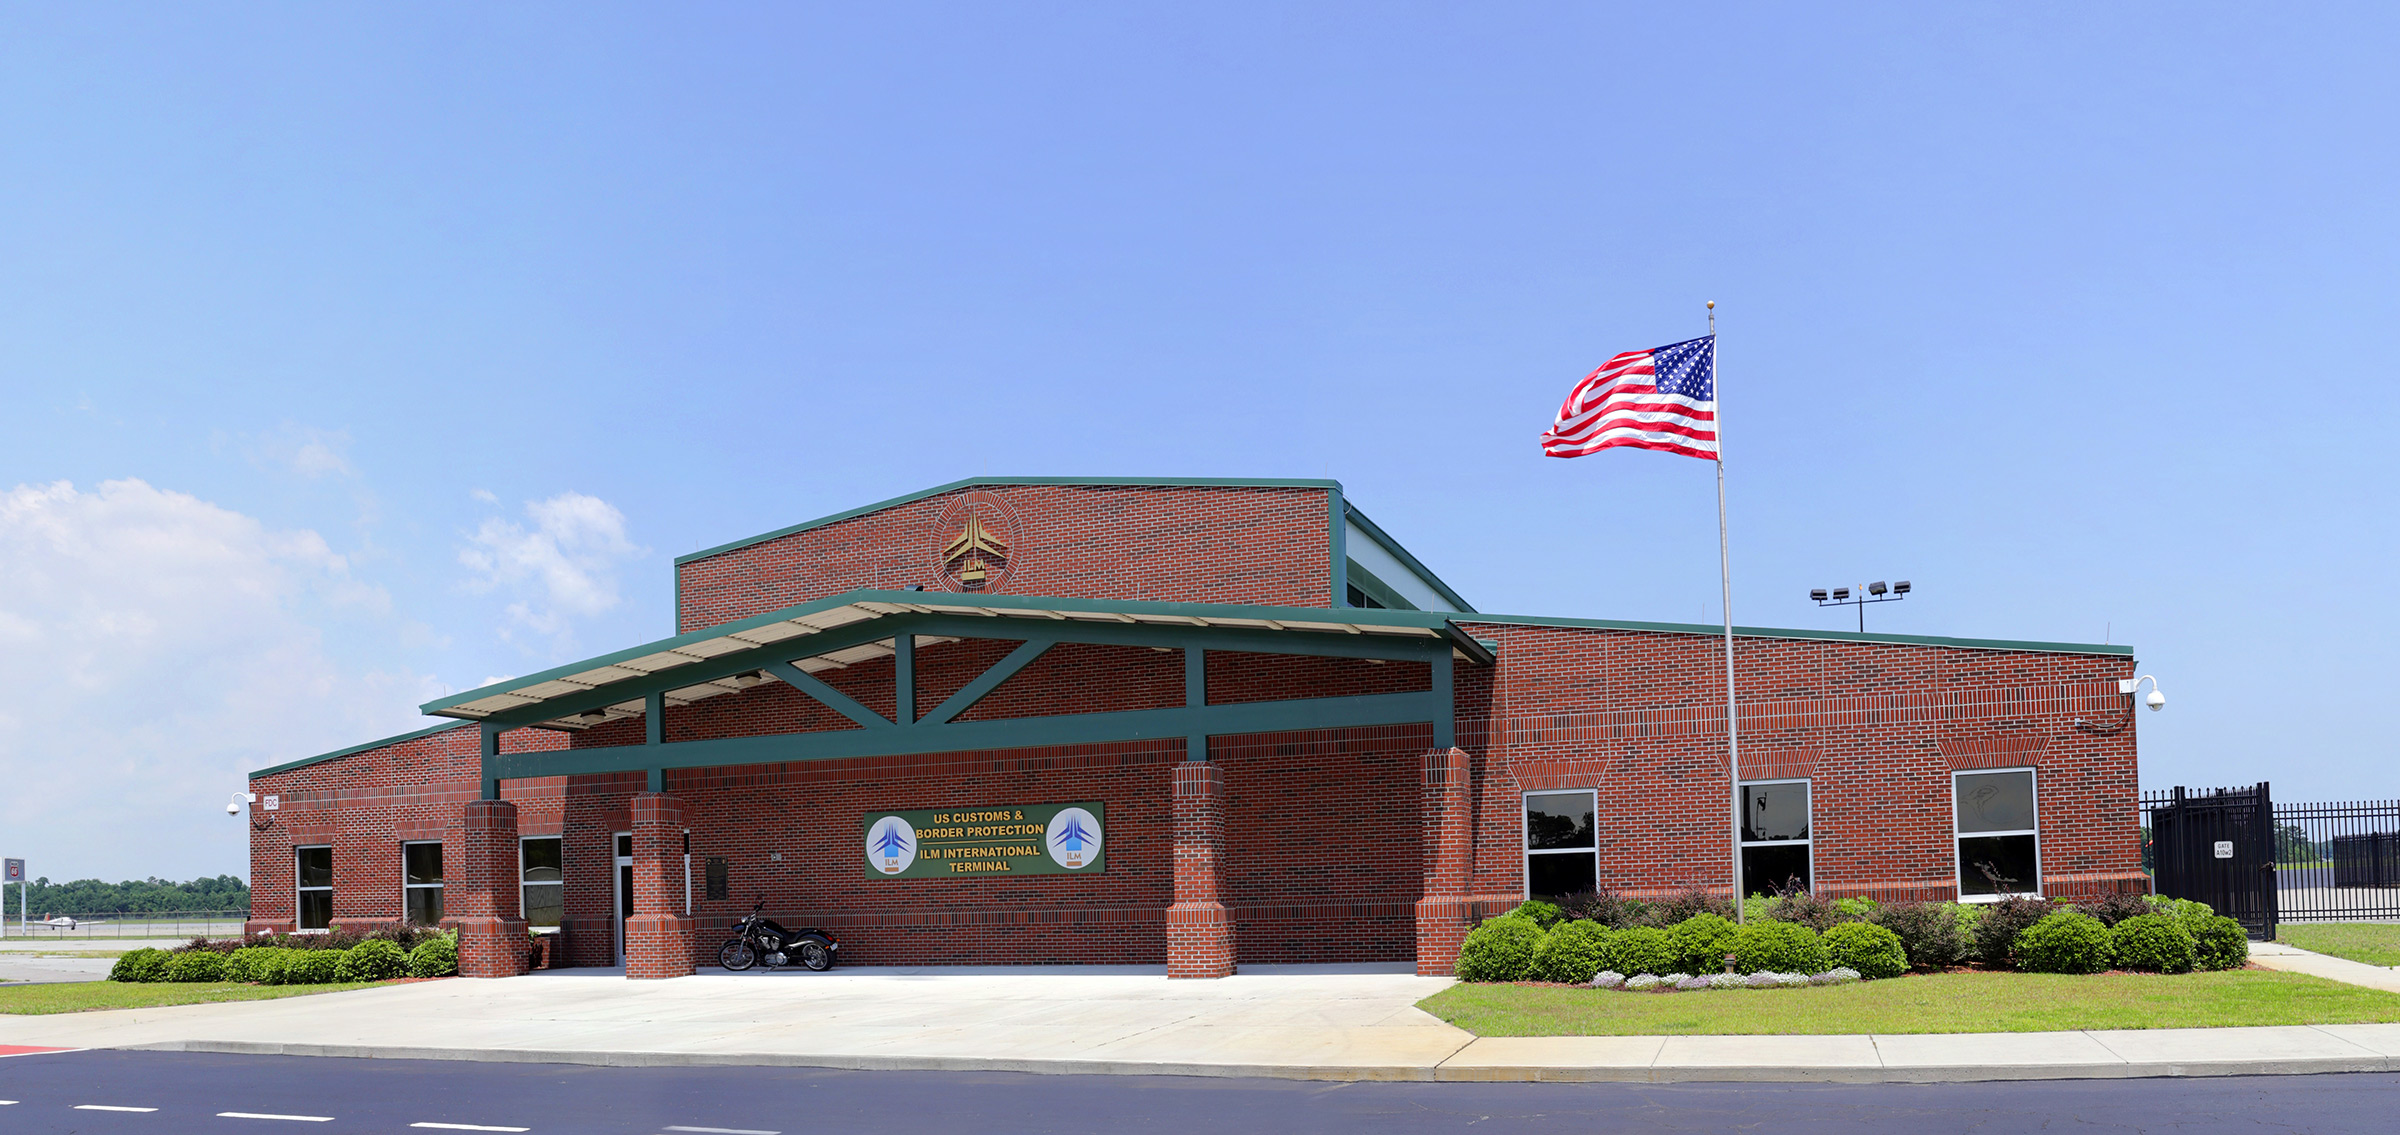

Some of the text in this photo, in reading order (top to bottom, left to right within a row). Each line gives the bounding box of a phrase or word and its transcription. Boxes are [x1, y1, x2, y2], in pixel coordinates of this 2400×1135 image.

[964, 559, 985, 571] ILM
[265, 799, 277, 807] FDC
[933, 810, 1024, 824] US CUSTOMS &
[916, 824, 1044, 839] BORDER PROTECTION
[920, 846, 1040, 860] ILM INTERNATIONAL
[1067, 852, 1082, 860] ILM
[949, 861, 1010, 872] TERMINAL
